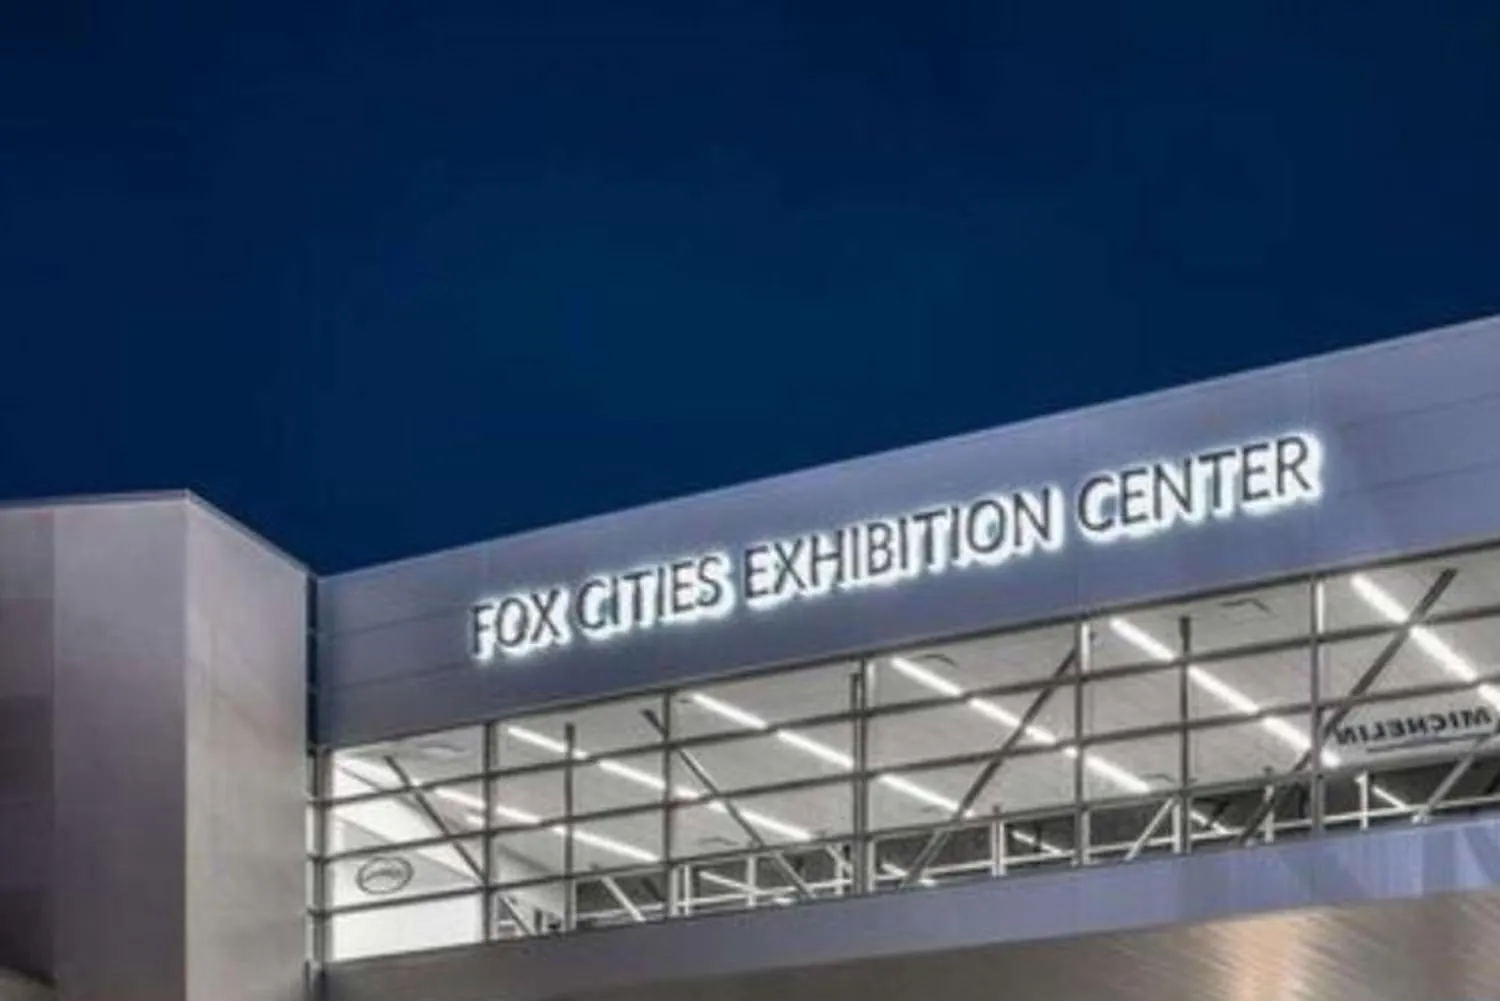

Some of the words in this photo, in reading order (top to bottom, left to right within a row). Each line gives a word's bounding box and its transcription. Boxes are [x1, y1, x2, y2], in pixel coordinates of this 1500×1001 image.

[471, 585, 568, 658] FOX
[575, 555, 733, 634] CITIES
[744, 486, 1061, 603] EXHIBITION
[1076, 434, 1319, 540] CENTER
